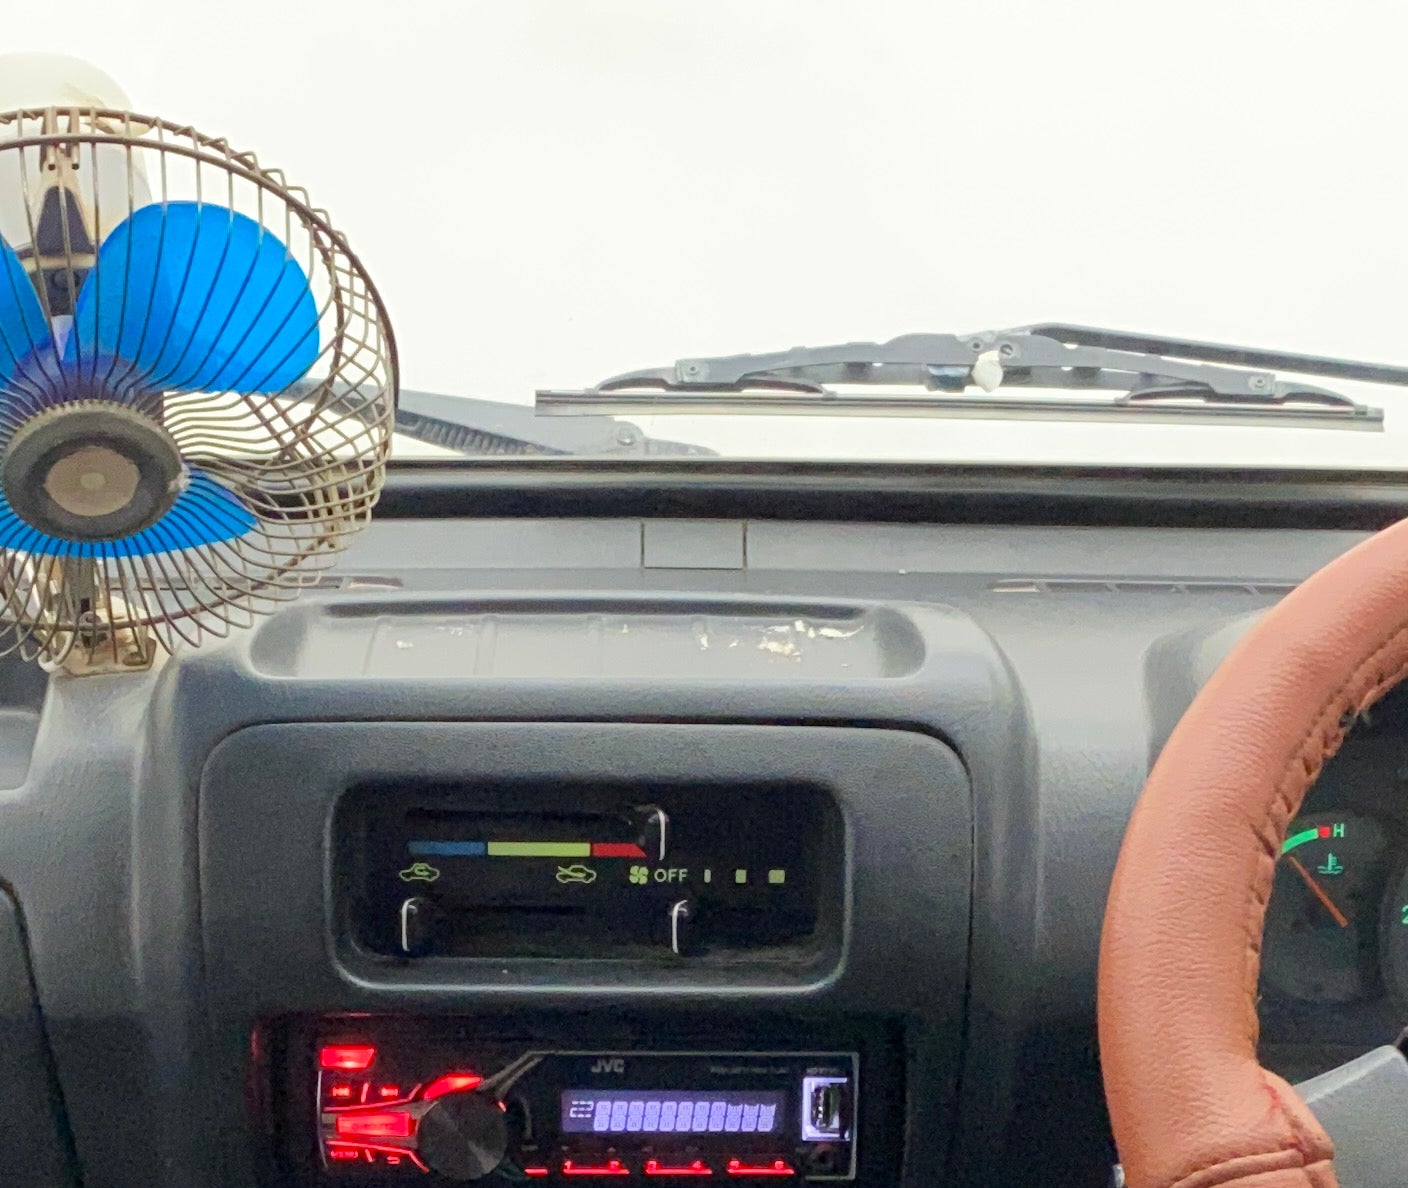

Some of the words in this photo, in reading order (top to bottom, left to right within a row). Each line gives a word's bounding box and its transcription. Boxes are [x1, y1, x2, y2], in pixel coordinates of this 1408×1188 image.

[1333, 825, 1345, 838] H
[654, 868, 688, 883] OFF
[591, 1059, 625, 1073] JVC
